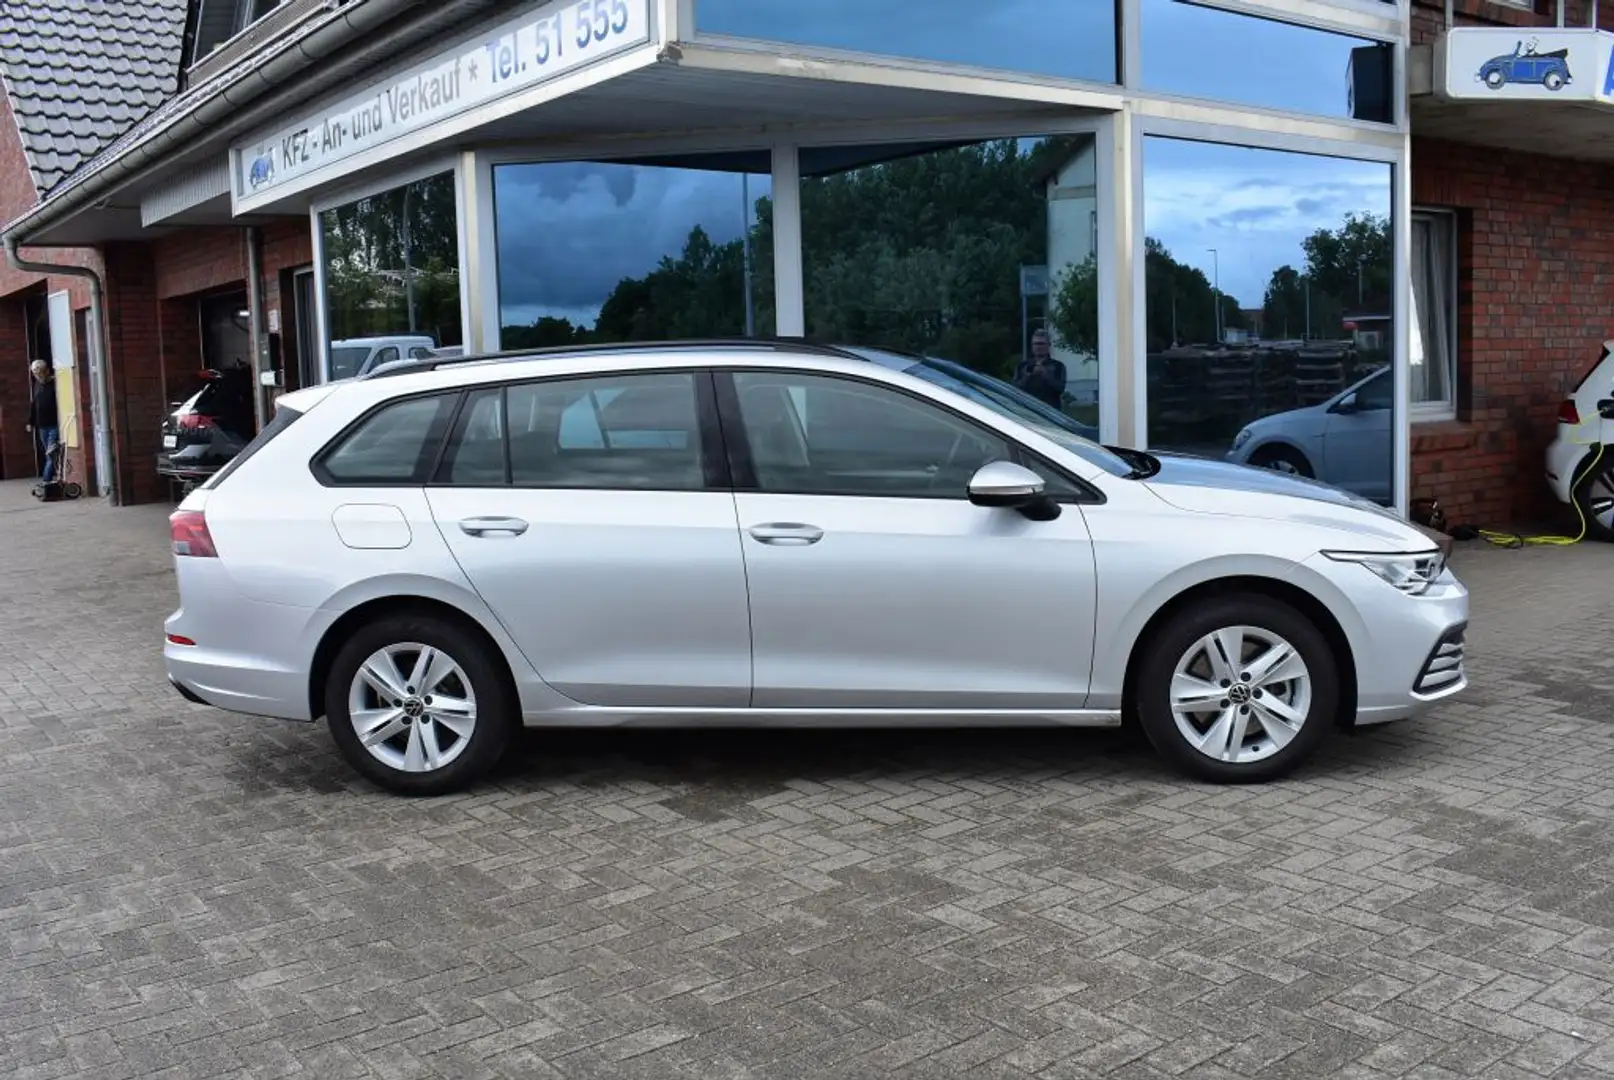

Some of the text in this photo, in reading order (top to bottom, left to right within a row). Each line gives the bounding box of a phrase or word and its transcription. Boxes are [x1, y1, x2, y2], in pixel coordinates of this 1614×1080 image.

[282, 128, 309, 169] KFZ
[352, 94, 383, 140] und
[386, 58, 461, 124] Verkauf
[485, 32, 526, 83] Tel.
[536, 11, 562, 65] 51
[576, 0, 628, 48] 555
